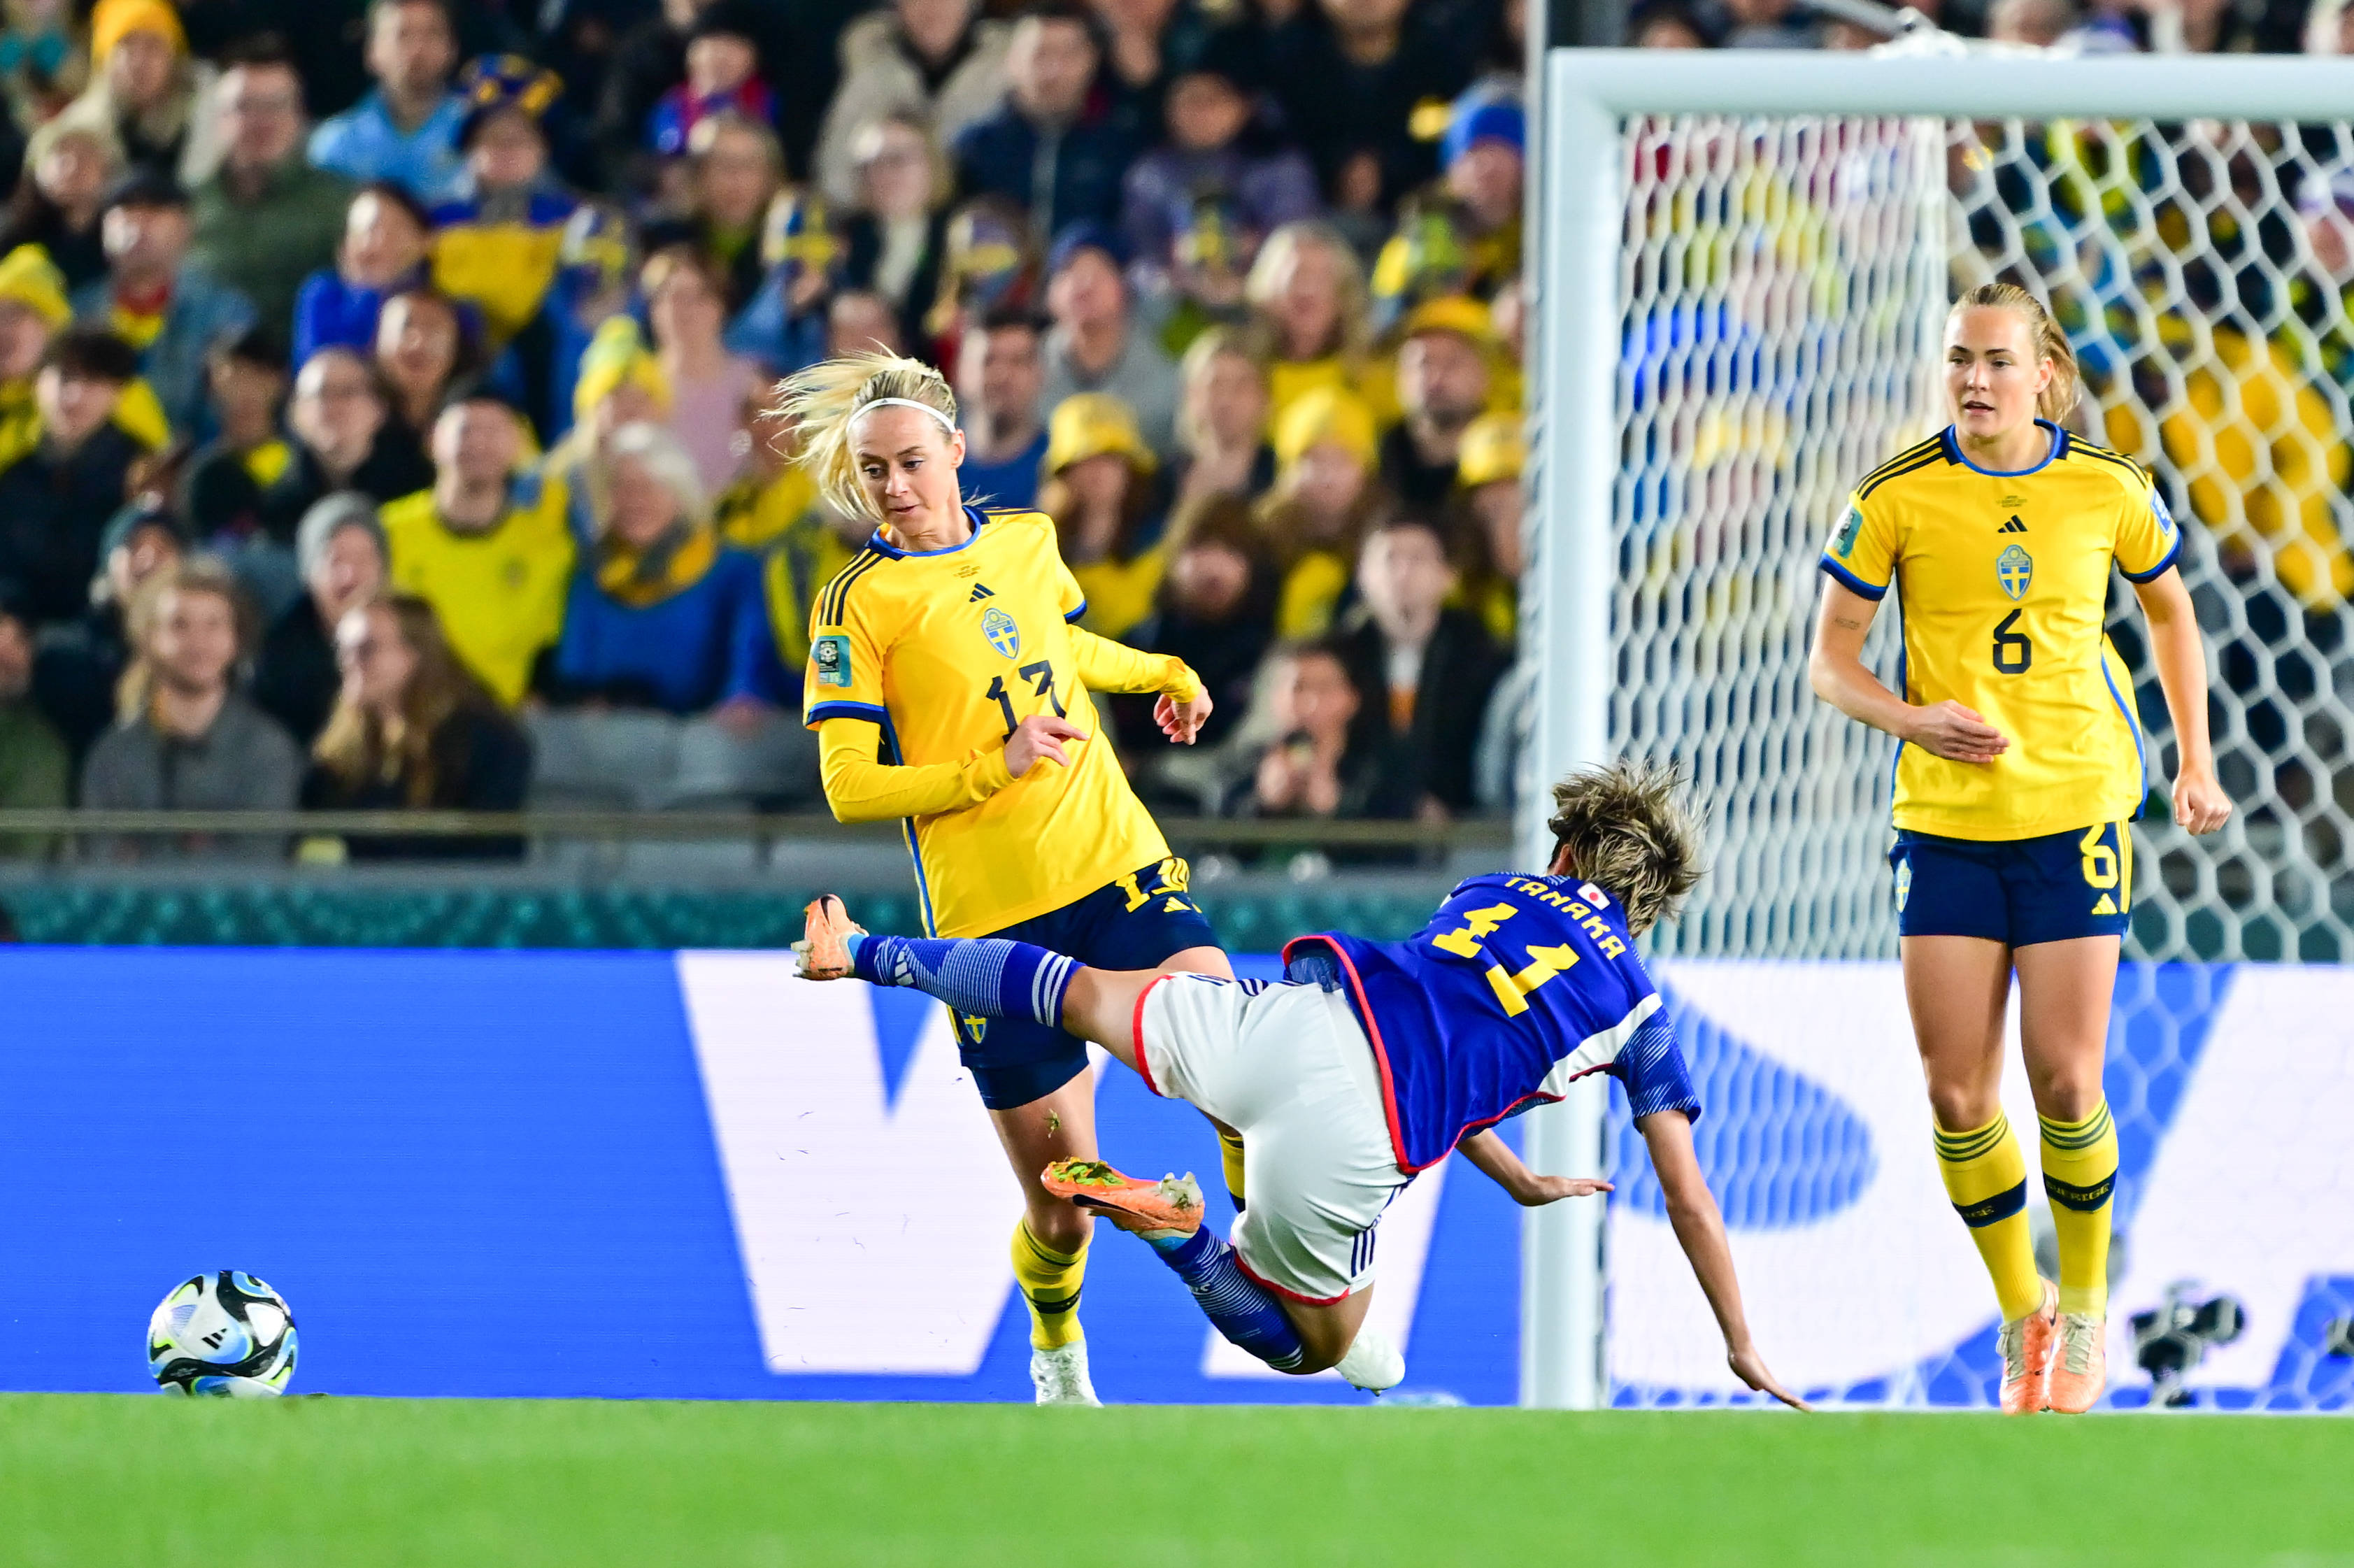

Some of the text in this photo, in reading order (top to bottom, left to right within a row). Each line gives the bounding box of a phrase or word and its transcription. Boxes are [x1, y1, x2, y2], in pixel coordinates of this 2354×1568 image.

[1992, 608, 2032, 675] 6
[2079, 822, 2120, 890] 6
[1504, 876, 1627, 961] TANAKA
[1432, 902, 1581, 1018] 11
